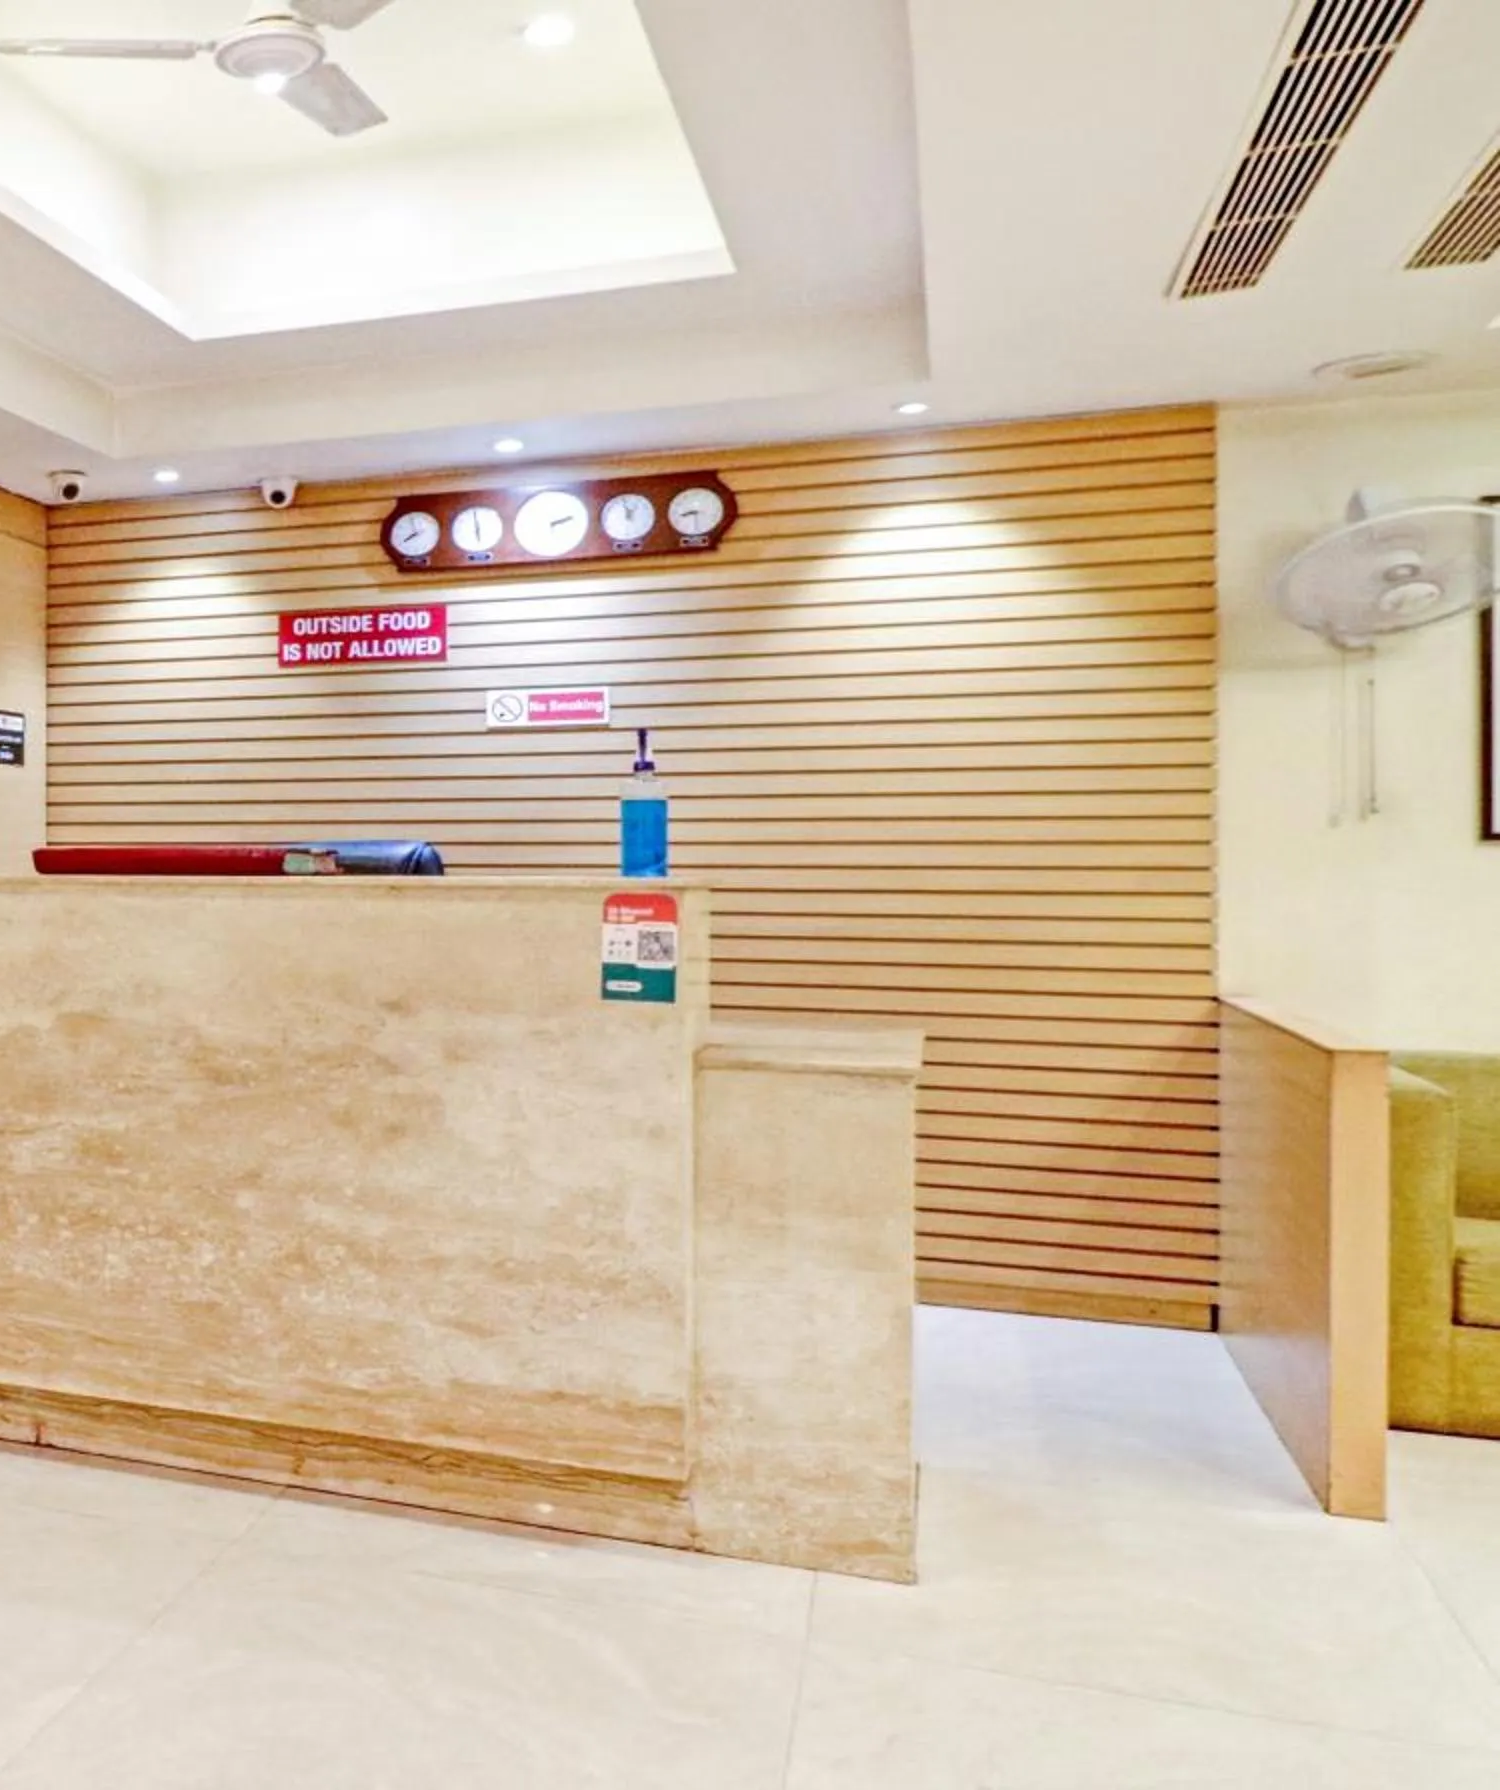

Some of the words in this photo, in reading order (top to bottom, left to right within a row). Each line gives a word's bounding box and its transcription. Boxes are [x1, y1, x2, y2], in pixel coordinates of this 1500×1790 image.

[293, 614, 373, 636] OUTSIDE
[378, 611, 431, 632] FOOD
[282, 643, 301, 662] IS
[306, 641, 344, 660] NOT
[348, 636, 442, 659] ALLOWED
[529, 702, 547, 713] No
[549, 699, 603, 713] Smoking
